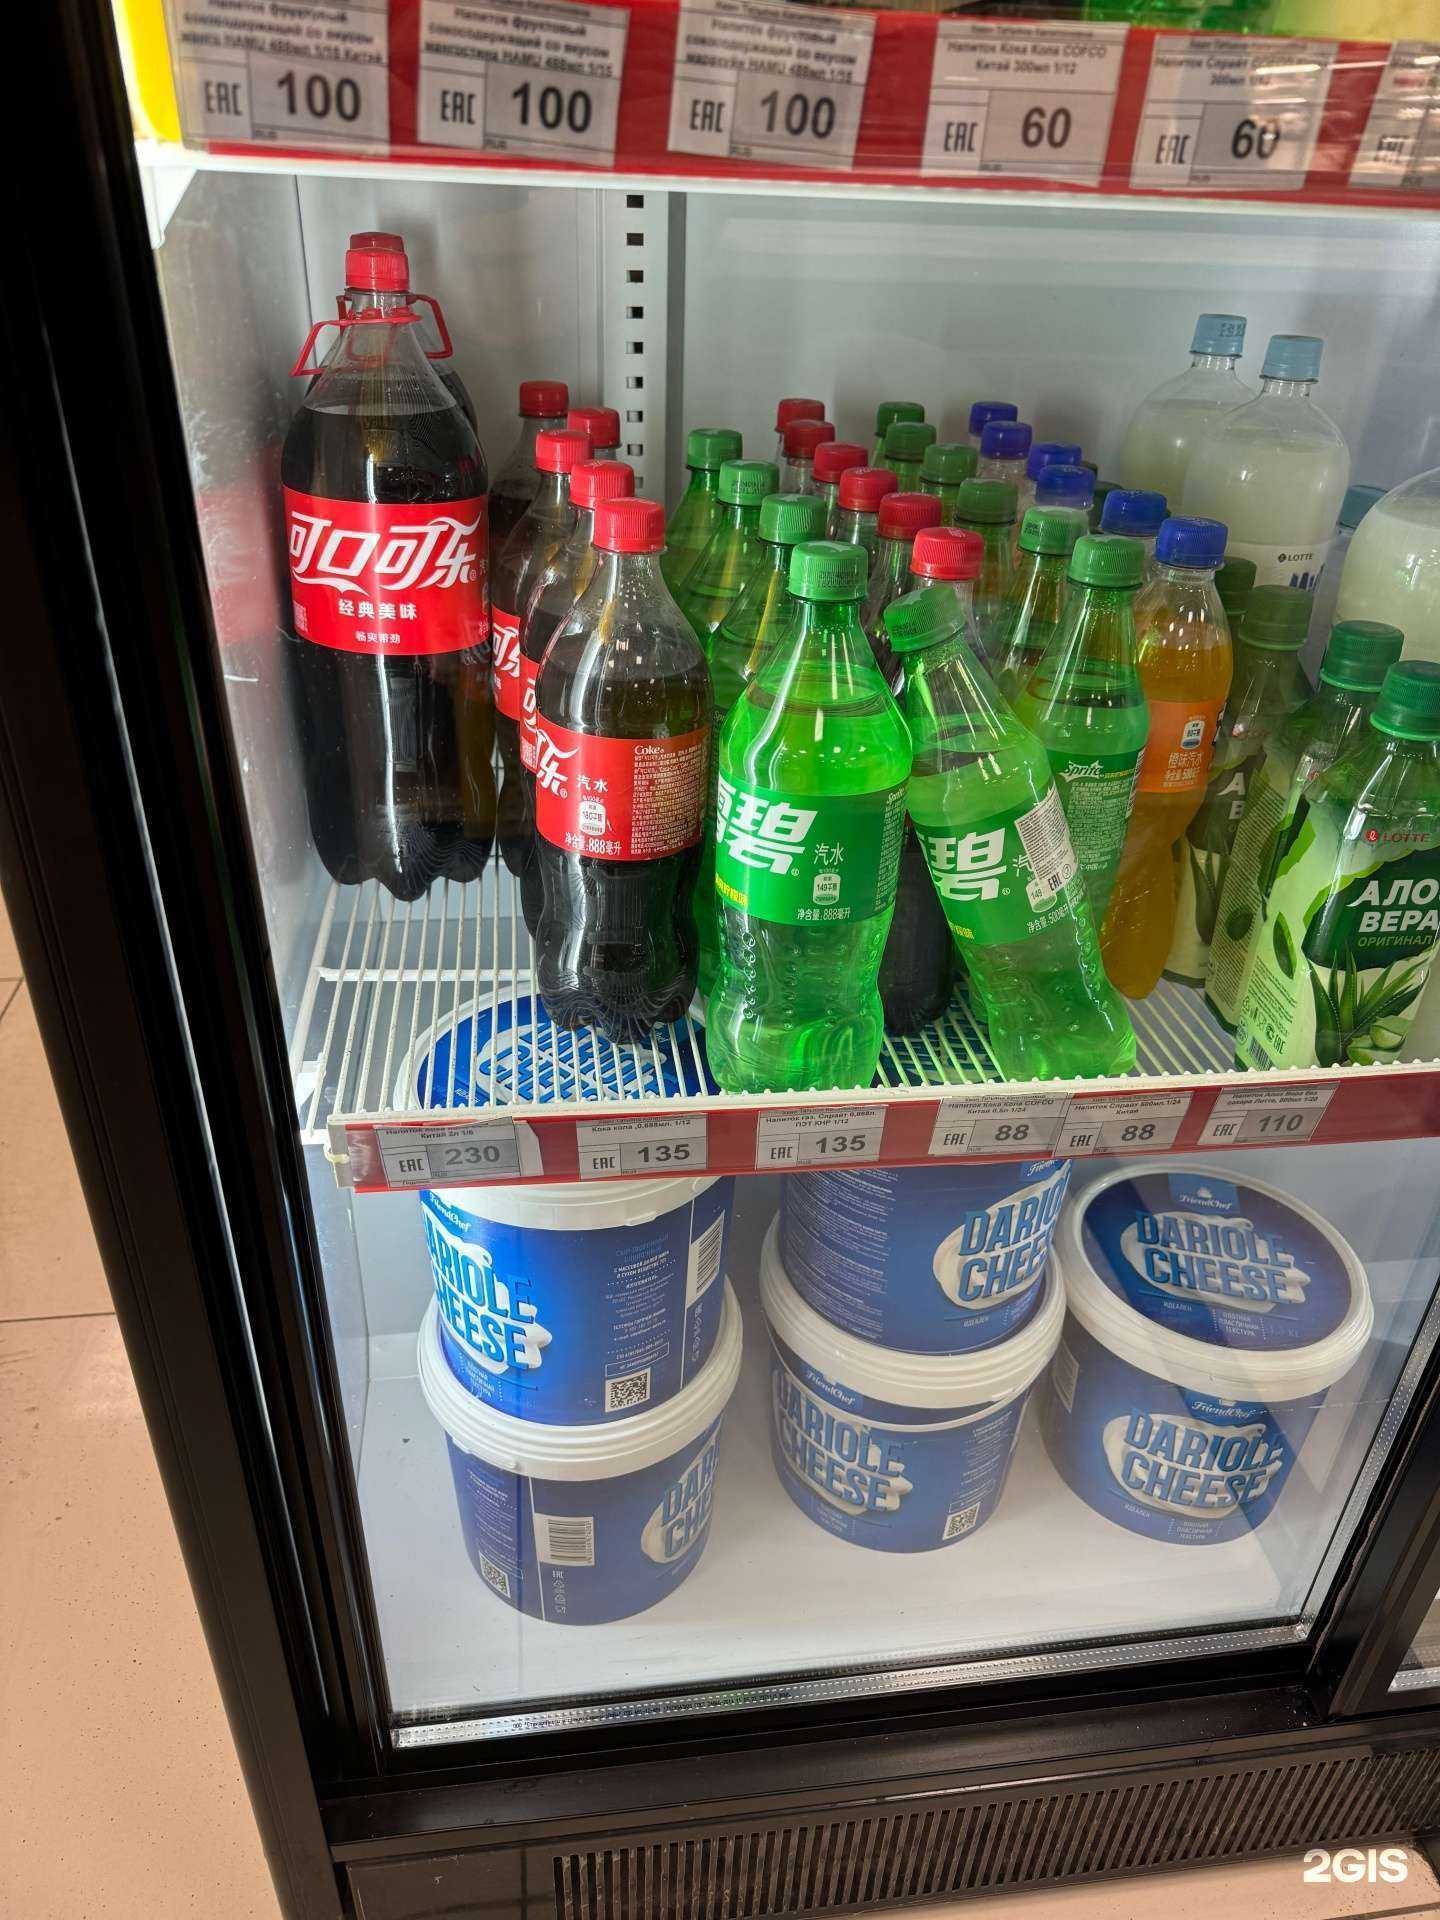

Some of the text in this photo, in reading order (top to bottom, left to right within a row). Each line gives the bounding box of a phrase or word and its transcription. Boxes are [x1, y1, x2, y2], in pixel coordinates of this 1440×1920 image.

[512, 16, 586, 36] фруктовый
[947, 41, 998, 55] Напиток
[204, 80, 243, 117] EAC
[277, 69, 361, 122] 100
[440, 90, 477, 125] EAC
[512, 80, 593, 134] 100
[689, 99, 726, 133] EAC
[760, 89, 837, 140] 100
[943, 120, 979, 152] EAC
[1021, 105, 1072, 149] 60
[1155, 133, 1192, 164] EAC
[1231, 118, 1280, 160] 60
[290, 510, 482, 592] 可口可乐
[1287, 552, 1314, 562] LOTTE
[337, 598, 417, 621] 经典美味
[634, 744, 660, 756] Coke
[1062, 760, 1104, 783] Sprite
[576, 774, 609, 793] 汽水
[1382, 831, 1432, 844] LOTTE
[813, 842, 844, 867] 汽水
[1345, 877, 1440, 909] АЛО
[1358, 910, 1440, 933] ВЕРА
[766, 1115, 801, 1124] Напиток
[818, 1111, 848, 1121] Спрайт
[1074, 1104, 1108, 1112] Напиток
[1109, 1102, 1138, 1110] Спрайт
[1115, 1108, 1140, 1116] Китай
[795, 1118, 849, 1128] ПЭТ КНР 1/12
[994, 1123, 1030, 1142] 88
[1121, 1123, 1156, 1142] 88
[1212, 1123, 1238, 1137] EAC
[1258, 1113, 1304, 1133] 110
[815, 1134, 867, 1155] 135
[942, 1132, 968, 1146] EAC
[1069, 1133, 1094, 1148] EAC
[444, 1145, 501, 1166] 230
[592, 1156, 616, 1170] EAC
[637, 1143, 691, 1163] 135
[770, 1146, 793, 1160] EAC
[398, 1157, 425, 1173] EAC
[1180, 1192, 1234, 1211] FriendChef
[959, 1175, 1071, 1257] DARIO
[1134, 1209, 1292, 1269] DARIOLE
[958, 1229, 1050, 1302] CHEE
[1143, 1247, 1289, 1305] CHEESE
[1191, 1400, 1256, 1418] FriendChef
[1124, 1408, 1288, 1473] DARIOLE
[1121, 1450, 1267, 1509] CHEESE
